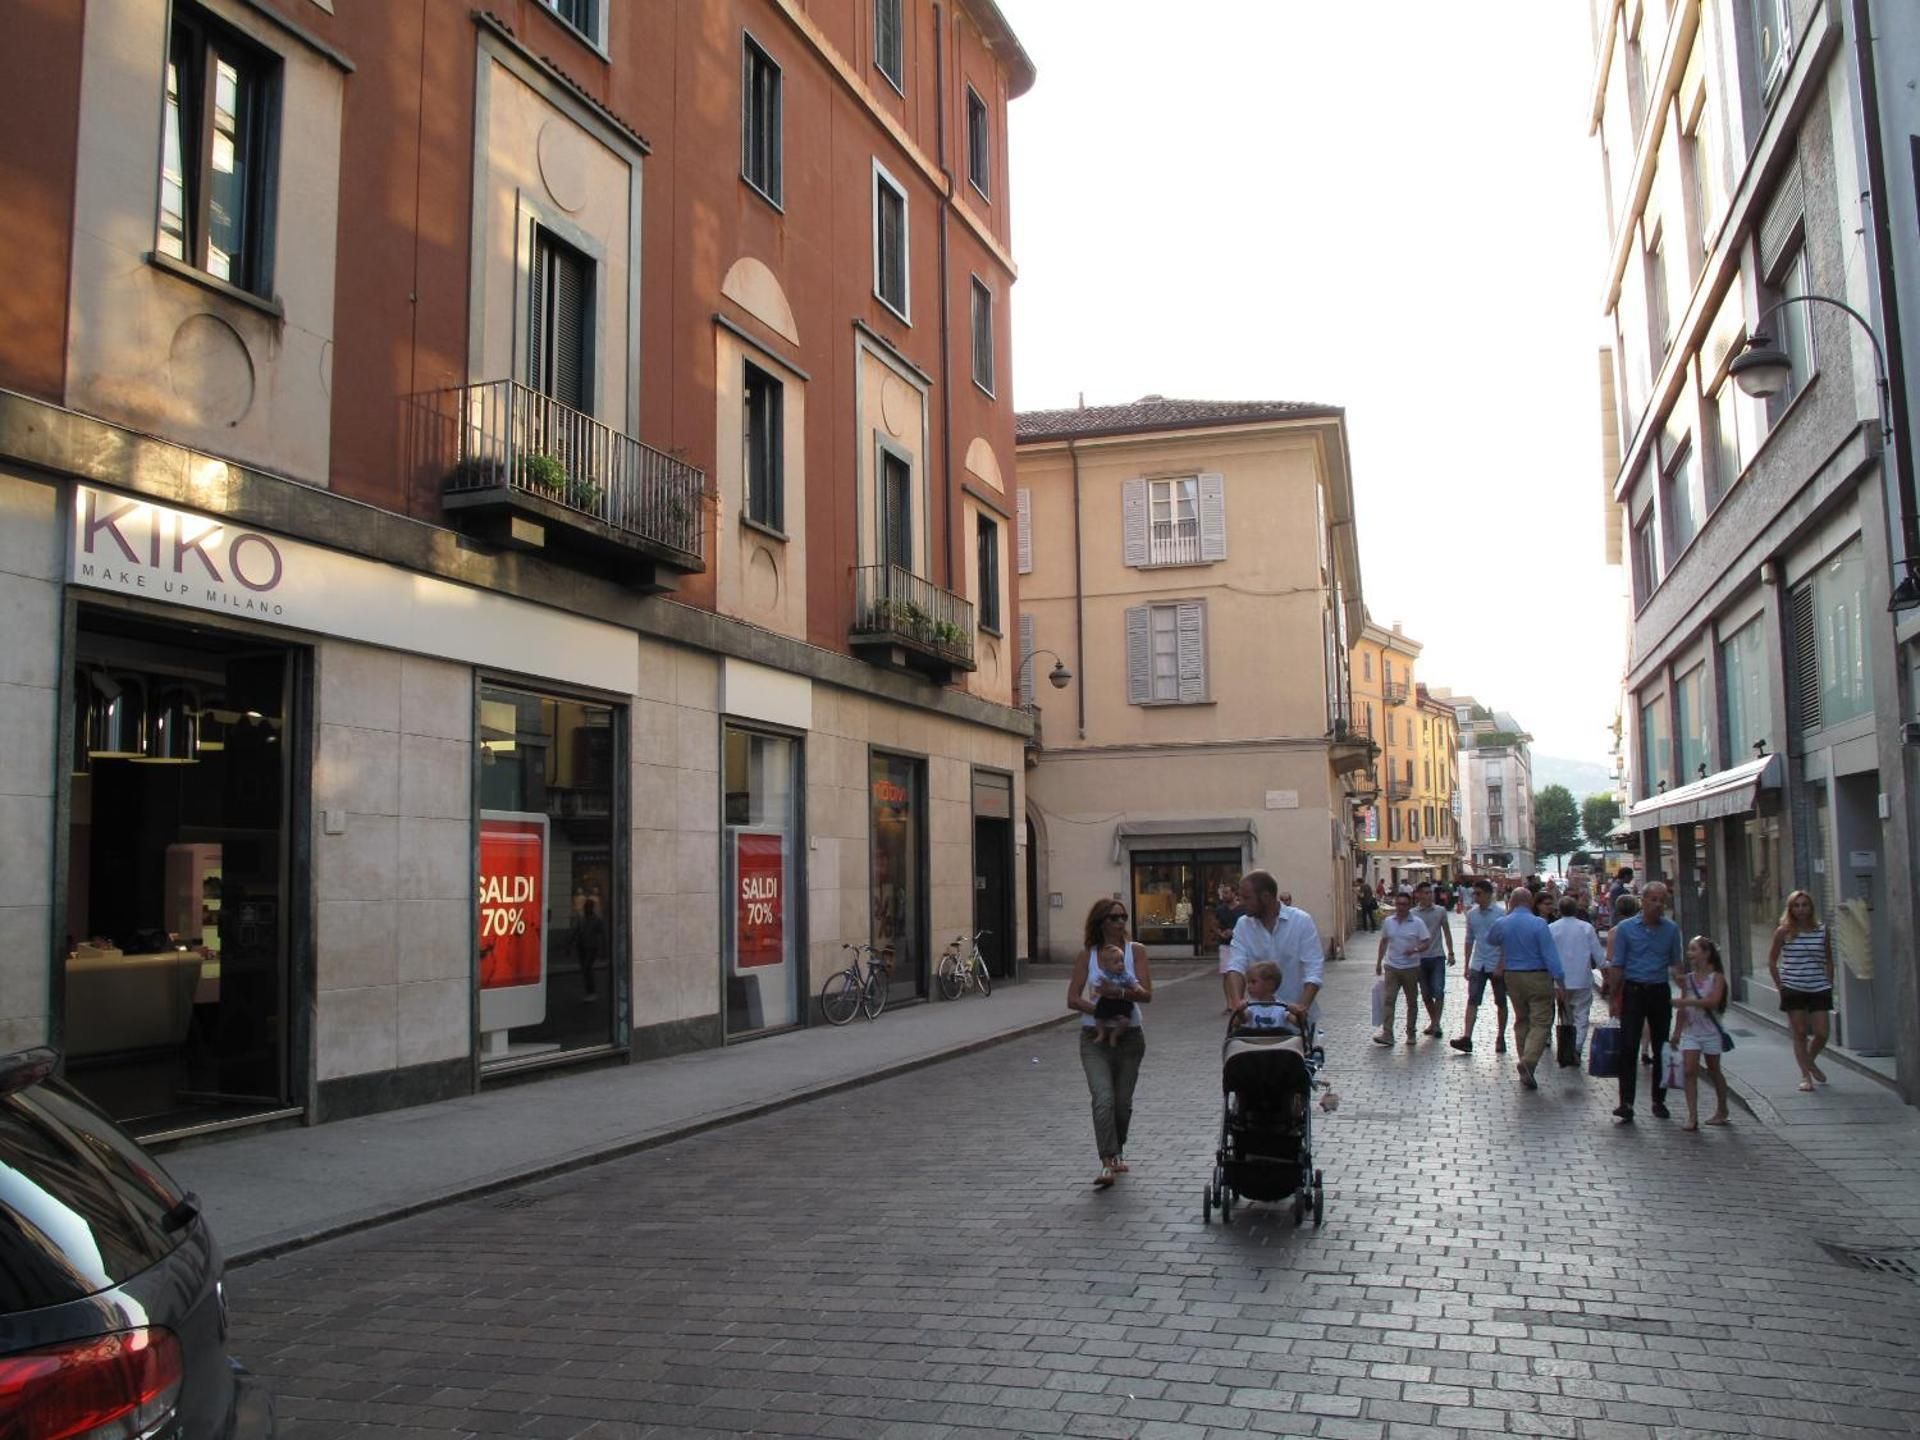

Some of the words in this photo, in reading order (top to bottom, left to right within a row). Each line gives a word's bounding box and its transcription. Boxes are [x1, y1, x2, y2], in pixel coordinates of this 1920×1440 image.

[84, 491, 283, 592] KIKO
[82, 563, 147, 587] MAKE
[164, 580, 189, 596] UP
[206, 590, 283, 616] MILANO
[742, 877, 778, 900] SALDI
[482, 908, 526, 937] 70%
[747, 903, 773, 926] 70%
